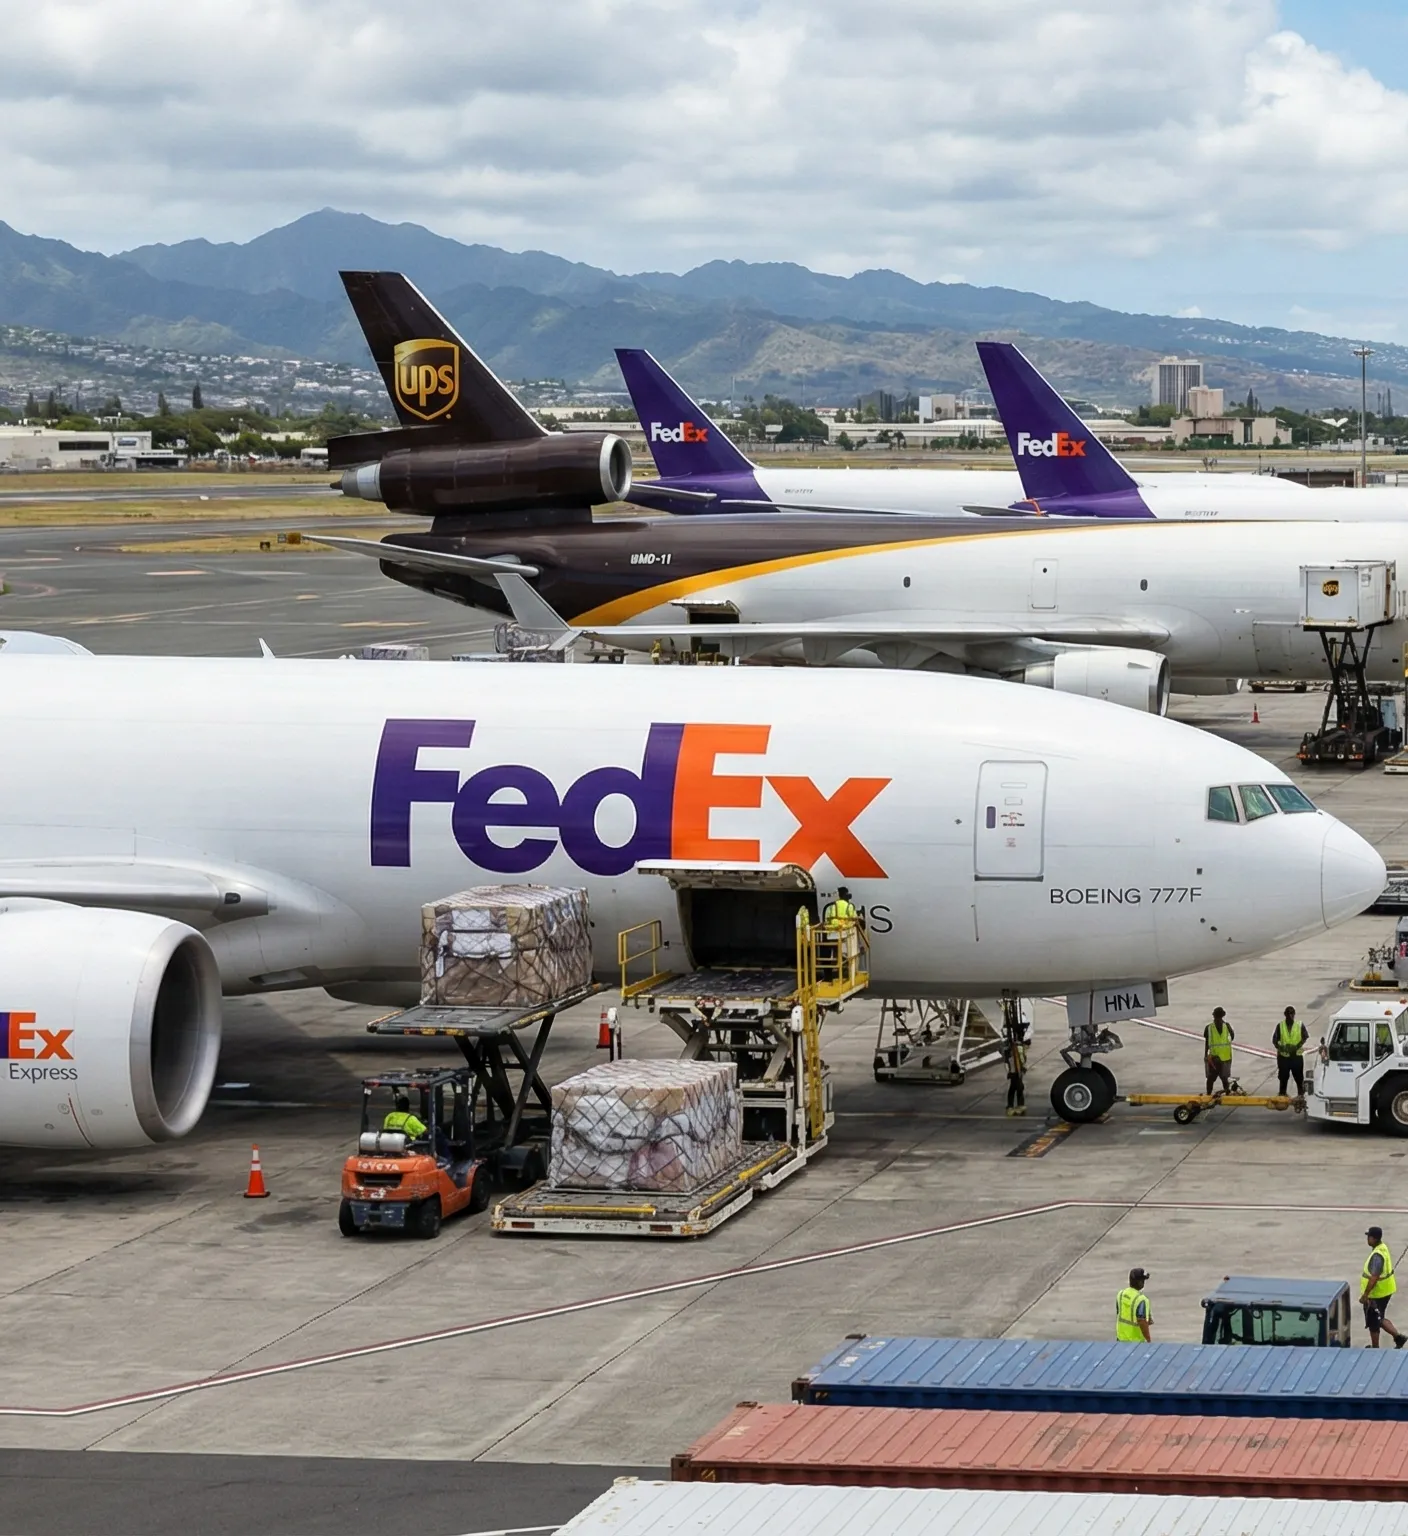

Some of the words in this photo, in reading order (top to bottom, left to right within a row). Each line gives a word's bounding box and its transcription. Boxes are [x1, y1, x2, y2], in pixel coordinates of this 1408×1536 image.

[400, 364, 454, 406] ups
[650, 421, 709, 442] FedEx
[1017, 432, 1086, 457] FedEx
[371, 718, 892, 879] FedEx
[1050, 888, 1142, 904] BOEING
[1149, 887, 1203, 903] 777F
[0, 1012, 74, 1060] Ex
[9, 1062, 78, 1084] Express
